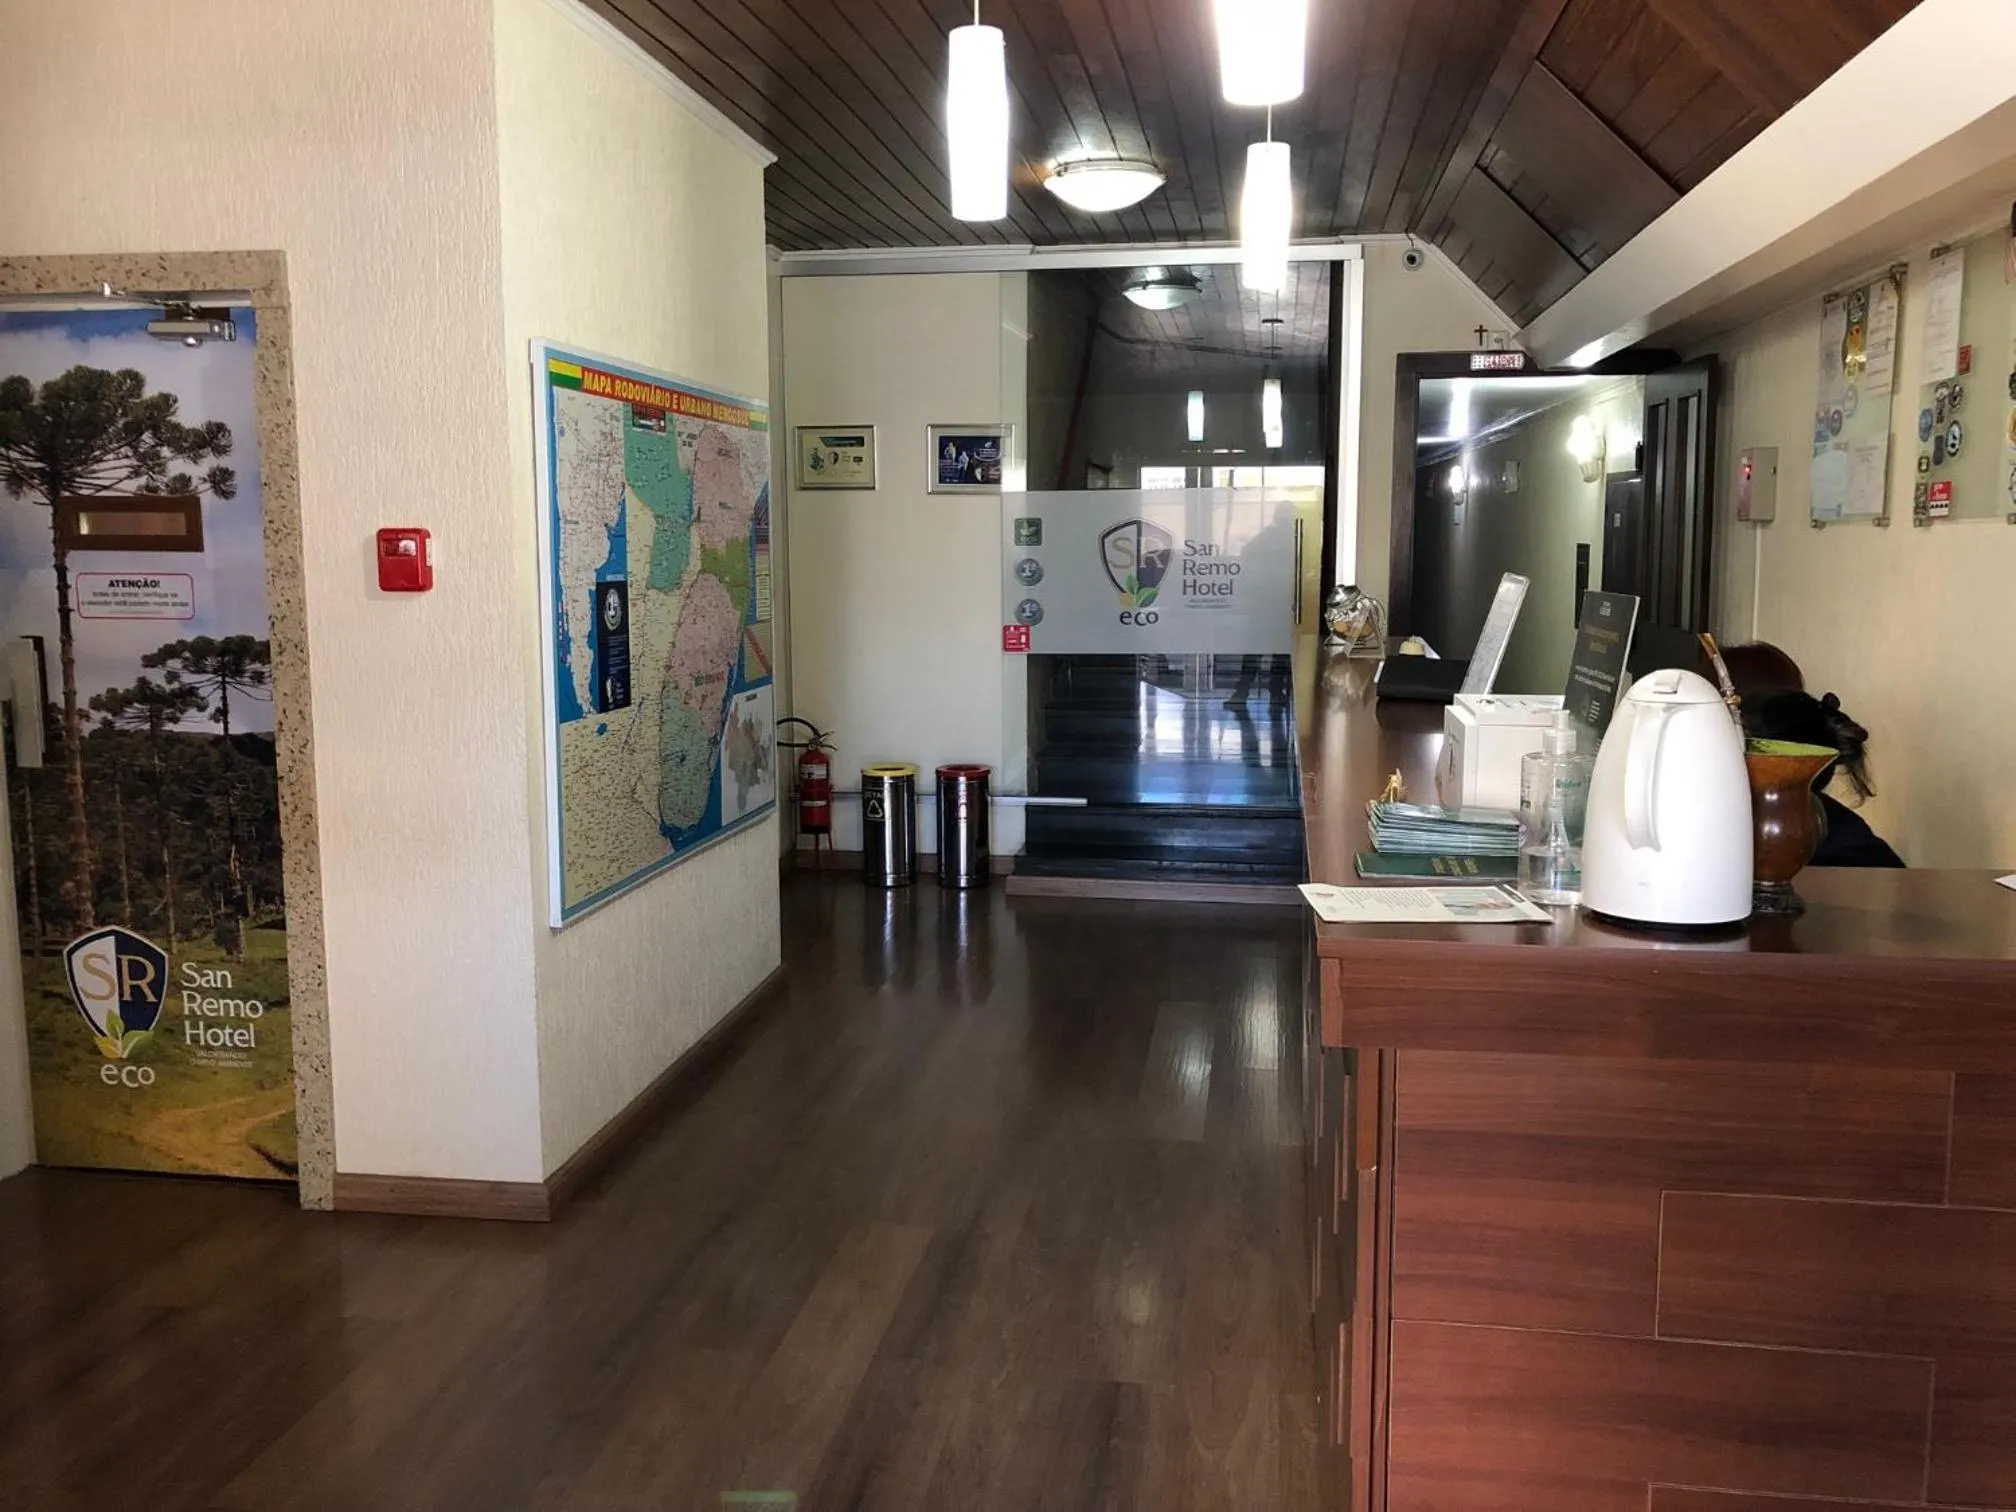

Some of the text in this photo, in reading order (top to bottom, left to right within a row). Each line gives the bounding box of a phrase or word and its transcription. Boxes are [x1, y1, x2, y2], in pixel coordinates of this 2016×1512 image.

[584, 370, 613, 394] MAPA
[615, 379, 670, 408] RODOVIÁRIO
[672, 393, 678, 409] E
[1183, 539, 1220, 557] San
[1183, 559, 1241, 576] Remo
[108, 578, 160, 589] ATENÇÃO!
[1182, 578, 1233, 597] Hotel
[1119, 610, 1159, 627] eco
[180, 961, 232, 989] San
[181, 990, 264, 1019] Remo
[184, 1020, 256, 1048] Hotel
[100, 1063, 155, 1088] eco
